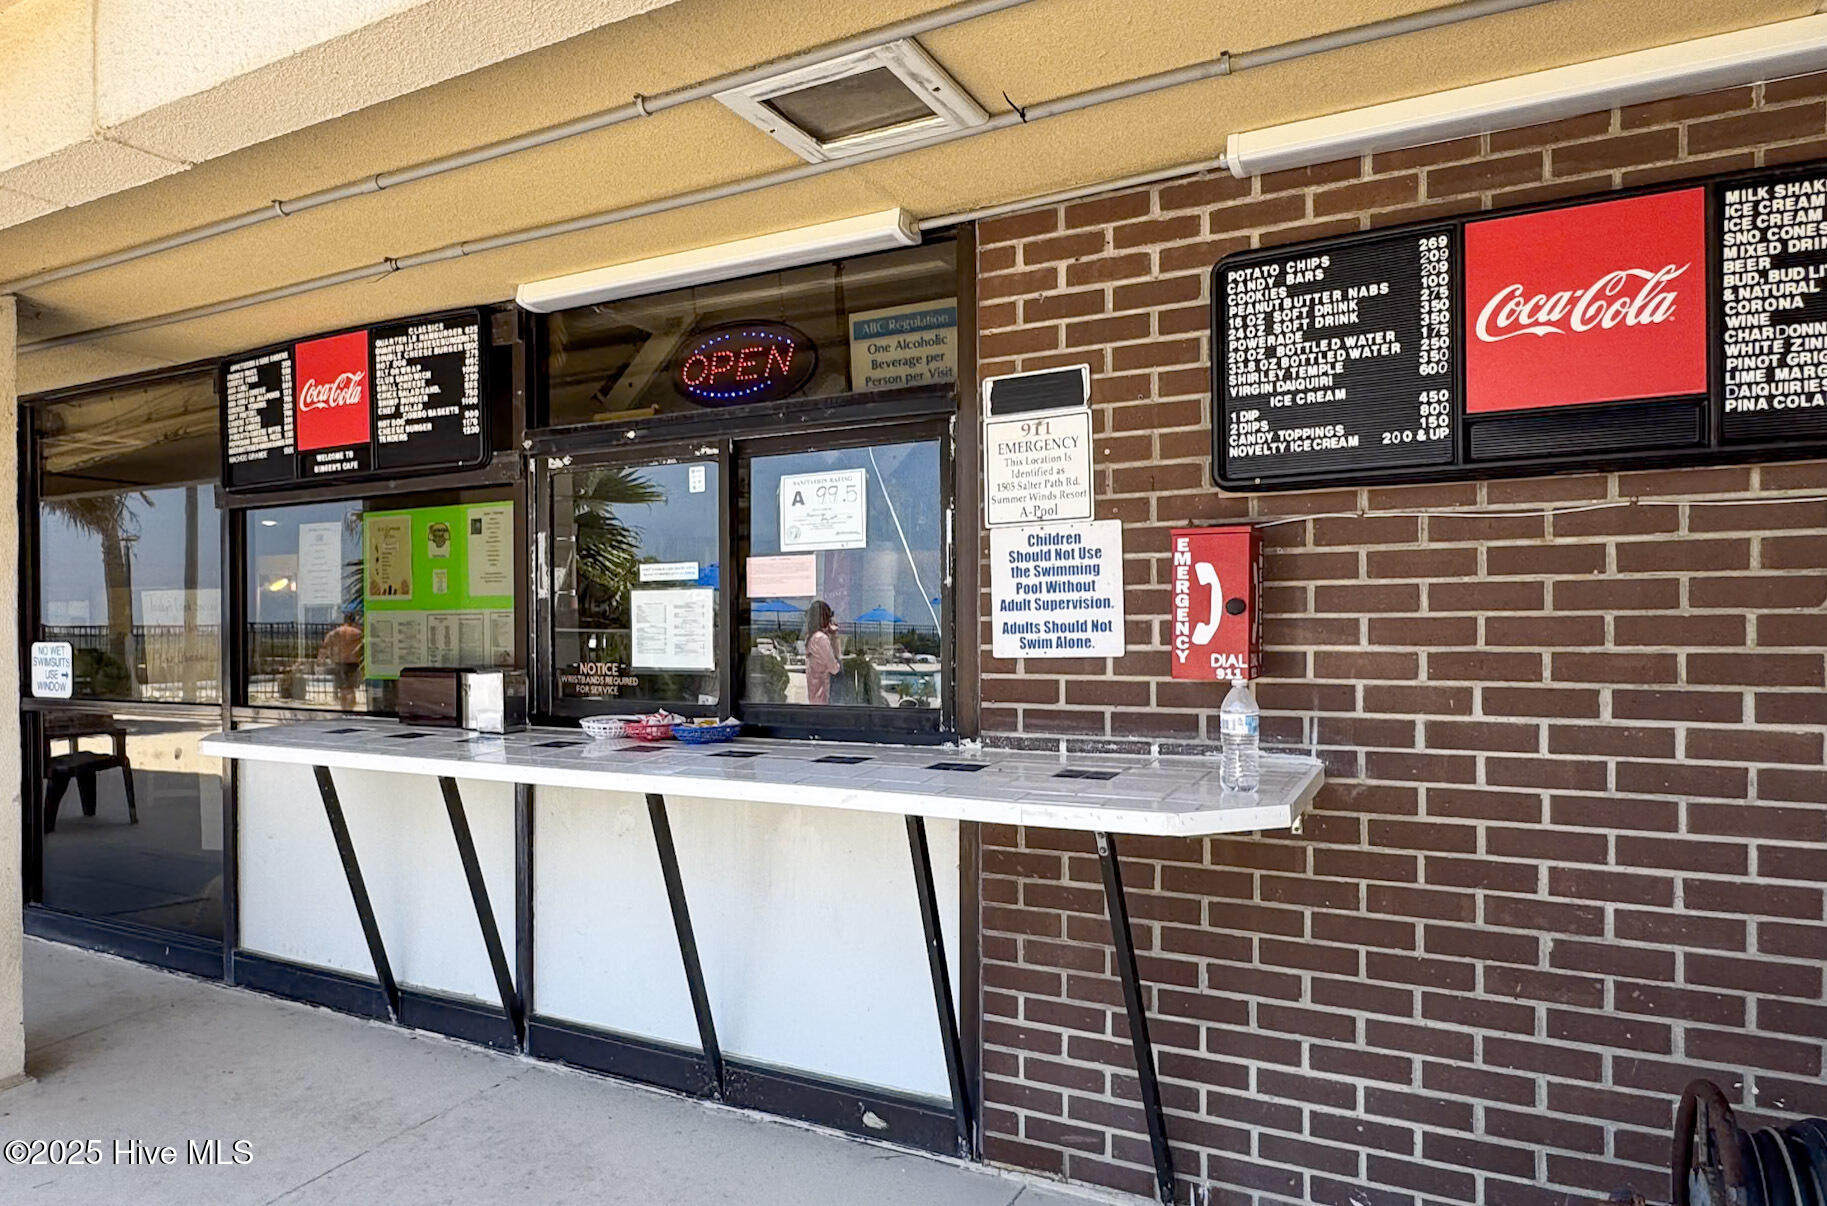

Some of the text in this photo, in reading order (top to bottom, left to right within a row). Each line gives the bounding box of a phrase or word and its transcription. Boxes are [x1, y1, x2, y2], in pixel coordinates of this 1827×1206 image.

[1725, 176, 1827, 204] MILK SHAK
[1724, 193, 1826, 218] ICE CREAM
[1724, 207, 1823, 232] ICE CREAM
[1723, 229, 1760, 247] SNO
[1227, 235, 1447, 283] POTATO CHIPS 269
[1723, 241, 1781, 260] MIXED
[1227, 247, 1448, 294] CANDY BARS 209
[1723, 256, 1770, 274] BEER
[1227, 260, 1448, 306] COOKIES 209
[1347, 282, 1388, 300] NABS
[1420, 273, 1448, 288] 100
[1723, 266, 1805, 289] BUD, BUD
[1723, 279, 1820, 301] & NATURAL
[1228, 285, 1449, 329] 16 OZ SOFT DRINK 275
[1475, 262, 1692, 342] Coca-Cola
[1724, 295, 1804, 315] CORONA
[862, 311, 950, 335] ABC Regulation
[1273, 318, 1309, 334] SOFT
[1314, 311, 1359, 328] DRINK
[1419, 297, 1449, 313] 350
[1725, 312, 1770, 329] WINE
[1228, 310, 1449, 351] POWERADE 350
[867, 333, 948, 355] One Alcoholic
[1276, 337, 1340, 357] BOTTLED
[1344, 330, 1395, 348] WATER
[1421, 323, 1449, 338] 175
[1724, 339, 1784, 357] WHITE
[871, 352, 946, 371] Beverage per
[1228, 335, 1449, 375] 33.8 OZ BOTTLED WATER 250
[1726, 354, 1780, 371] PINOT
[681, 342, 796, 387] OPEN
[1228, 348, 1449, 386] SHIRLEY TEMPLE 350
[865, 366, 953, 387] Person per Visit
[1229, 361, 1447, 398] VIRGIN DAIQUIRI 600
[1725, 369, 1766, 384] LIME
[299, 370, 365, 412] Coca-Cola
[1270, 388, 1346, 407] ICE CREAM
[1230, 388, 1448, 423] 1 DIP 450
[1420, 401, 1449, 416] 800
[1725, 397, 1768, 412] PINA
[1021, 420, 1052, 437] 911
[1229, 414, 1448, 446] CANDY TOPPINGS 150
[998, 436, 1079, 456] EMERGENCY
[1229, 442, 1287, 458] NOVELTY
[1381, 430, 1412, 444] 200
[1416, 428, 1427, 441] &
[1430, 426, 1449, 439] UP
[1004, 453, 1072, 467] This Location Is
[1011, 467, 1065, 478] Identified as
[1018, 480, 1042, 490] Salter
[1044, 478, 1064, 488] Path
[1066, 477, 1080, 486] Rd.
[792, 490, 805, 506] A
[991, 490, 1087, 504] Summer Winds Resort
[1020, 503, 1058, 518] A-Pool
[1028, 532, 1082, 546] Children
[1008, 546, 1102, 563] Should Not Use
[1011, 562, 1100, 578] the Swimming
[1016, 579, 1096, 595] Pool Without
[1000, 596, 1114, 612] Adult Supervision.
[1174, 537, 1192, 664] EMERGENCY
[1002, 618, 1112, 635] Adults Should Not
[38, 646, 65, 656] NO WET
[1019, 635, 1095, 650] Swim Alone.
[33, 657, 70, 667] SWIMSUITS
[579, 662, 619, 675] NOTICE
[1210, 653, 1248, 668] DIAL
[44, 670, 59, 680] USE
[561, 675, 639, 686] WRISTBANDS REQUIRED
[1216, 668, 1243, 680] 911
[37, 680, 66, 692] WINDOW
[576, 685, 619, 695] FOR SERVICE
